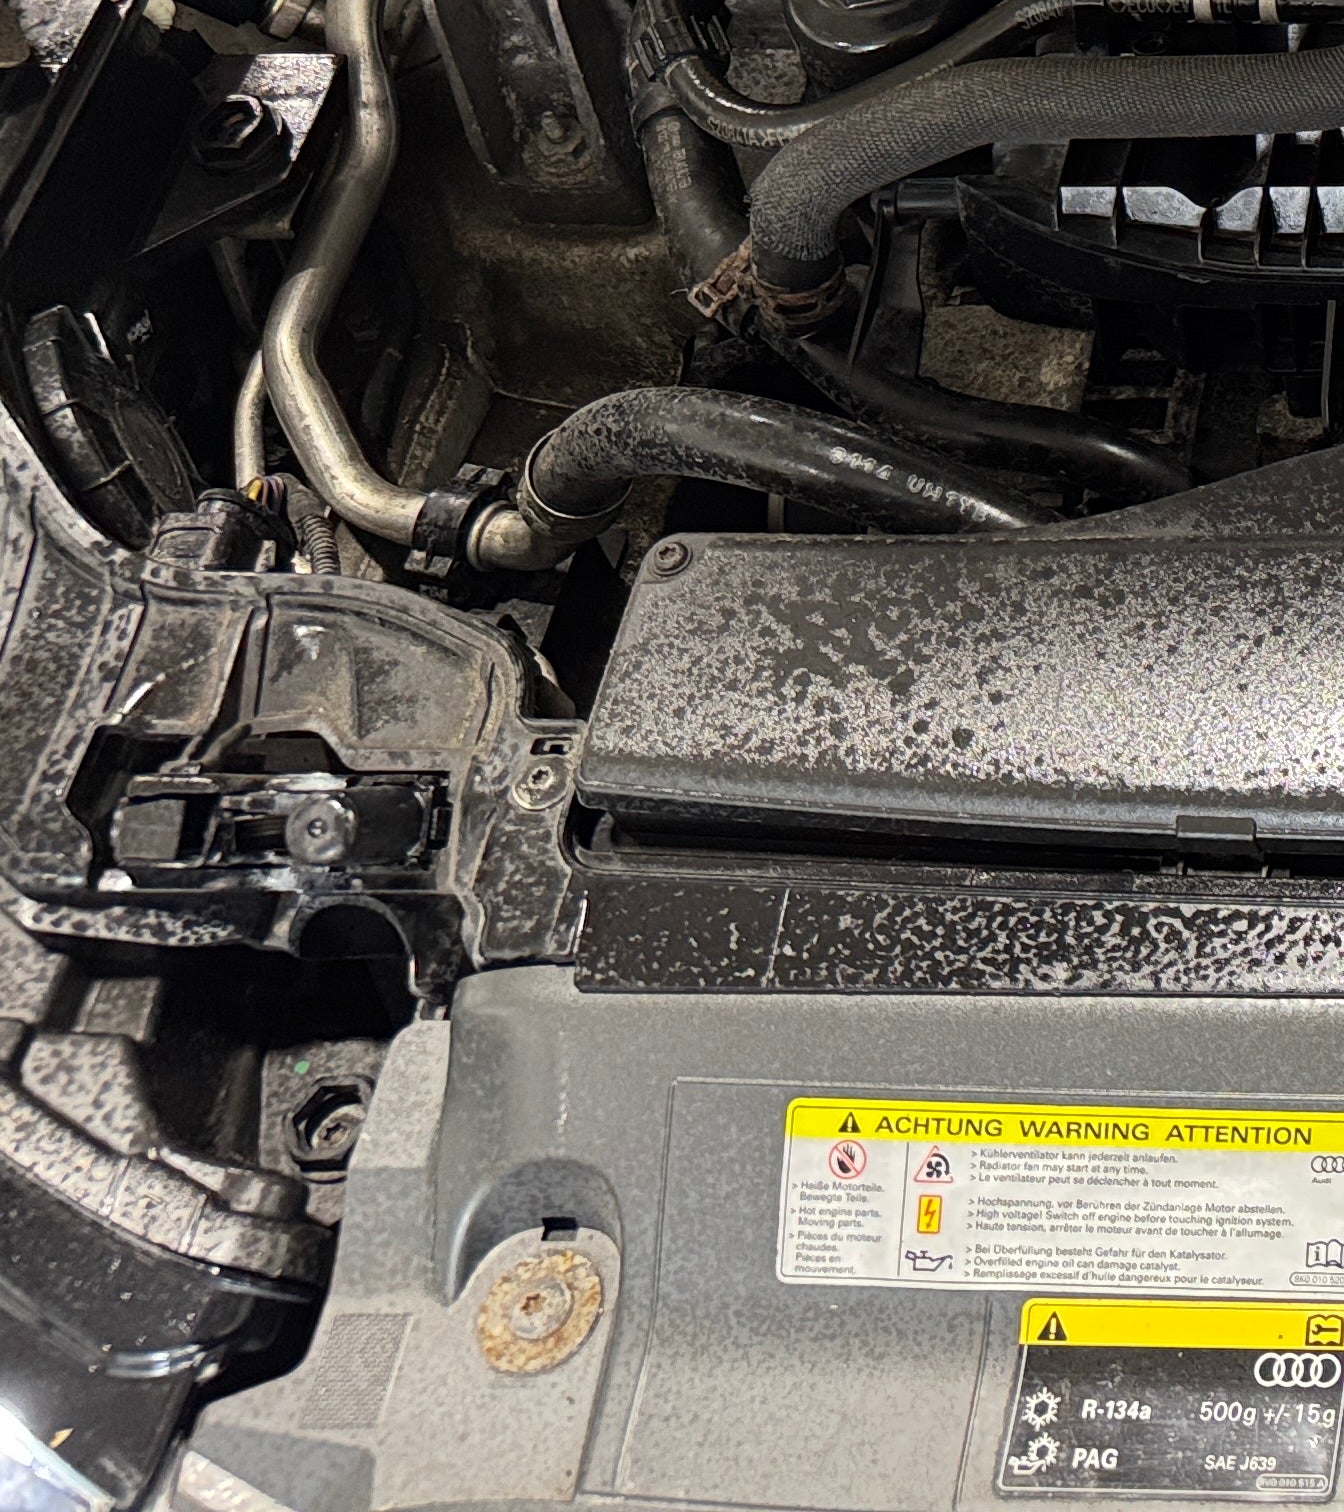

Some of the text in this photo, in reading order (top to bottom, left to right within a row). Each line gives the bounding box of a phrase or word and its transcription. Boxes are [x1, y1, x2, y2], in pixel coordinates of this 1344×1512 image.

[875, 1116, 1312, 1145] ACHTUNG WARNING ATTENTION
[1062, 1152, 1085, 1161] kann
[980, 1161, 1021, 1171] Radiator
[1024, 1162, 1039, 1171] fan
[1042, 1165, 1064, 1174] may
[1066, 1164, 1089, 1172] start
[1103, 1167, 1121, 1175] any
[1123, 1166, 1149, 1174] time.
[978, 1173, 990, 1182] Le
[994, 1174, 1046, 1184] ventilateur
[1048, 1176, 1071, 1185] peut
[1073, 1177, 1085, 1185] se
[1087, 1176, 1141, 1187] déclencher
[1151, 1179, 1171, 1188] tout
[1174, 1180, 1219, 1189] moment.
[799, 1207, 882, 1219] Hot engine parts.
[1057, 1201, 1074, 1209] vor
[1076, 1199, 1122, 1210] Berühren
[1124, 1201, 1140, 1210] der
[1142, 1201, 1203, 1213] Zündanlage
[1205, 1203, 1236, 1213] Motor
[1238, 1204, 1286, 1214] abstellen.
[798, 1218, 864, 1229] Moving parts.
[976, 1209, 1000, 1219] High
[1046, 1211, 1079, 1221] Switch
[1082, 1211, 1096, 1221] off
[1098, 1214, 1132, 1223] engine
[1134, 1214, 1166, 1224] before
[1169, 1215, 1213, 1226] touching
[1216, 1216, 1253, 1227] ignition
[1255, 1218, 1295, 1228] system.
[975, 1221, 1004, 1231] Haute
[1086, 1225, 1094, 1233] le
[1097, 1227, 1132, 1235] moteur
[1135, 1228, 1163, 1236] avant
[1165, 1228, 1178, 1236] de
[1180, 1228, 1218, 1237] toucher
[831, 1232, 844, 1241] du
[846, 1234, 883, 1243] moteur
[975, 1244, 991, 1254] Bei
[1055, 1246, 1092, 1256] besteht
[1095, 1247, 1128, 1258] Gefahr
[1131, 1247, 1146, 1258] für
[1148, 1249, 1166, 1258] den
[1170, 1249, 1228, 1261] Katalysator.
[973, 1257, 1180, 1273] Overfilled engine oil can damage catalyst.
[973, 1268, 1038, 1280] Remplissage
[1040, 1270, 1079, 1280] excessif
[1118, 1273, 1171, 1284] dangereux
[1174, 1276, 1197, 1285] pour
[1200, 1275, 1209, 1283] le
[1211, 1275, 1264, 1286] catalyseur.
[1081, 1399, 1152, 1421] R-134a
[1199, 1401, 1257, 1426] 500g
[1072, 1448, 1118, 1469] PAG
[1204, 1455, 1277, 1471] SAE J639
